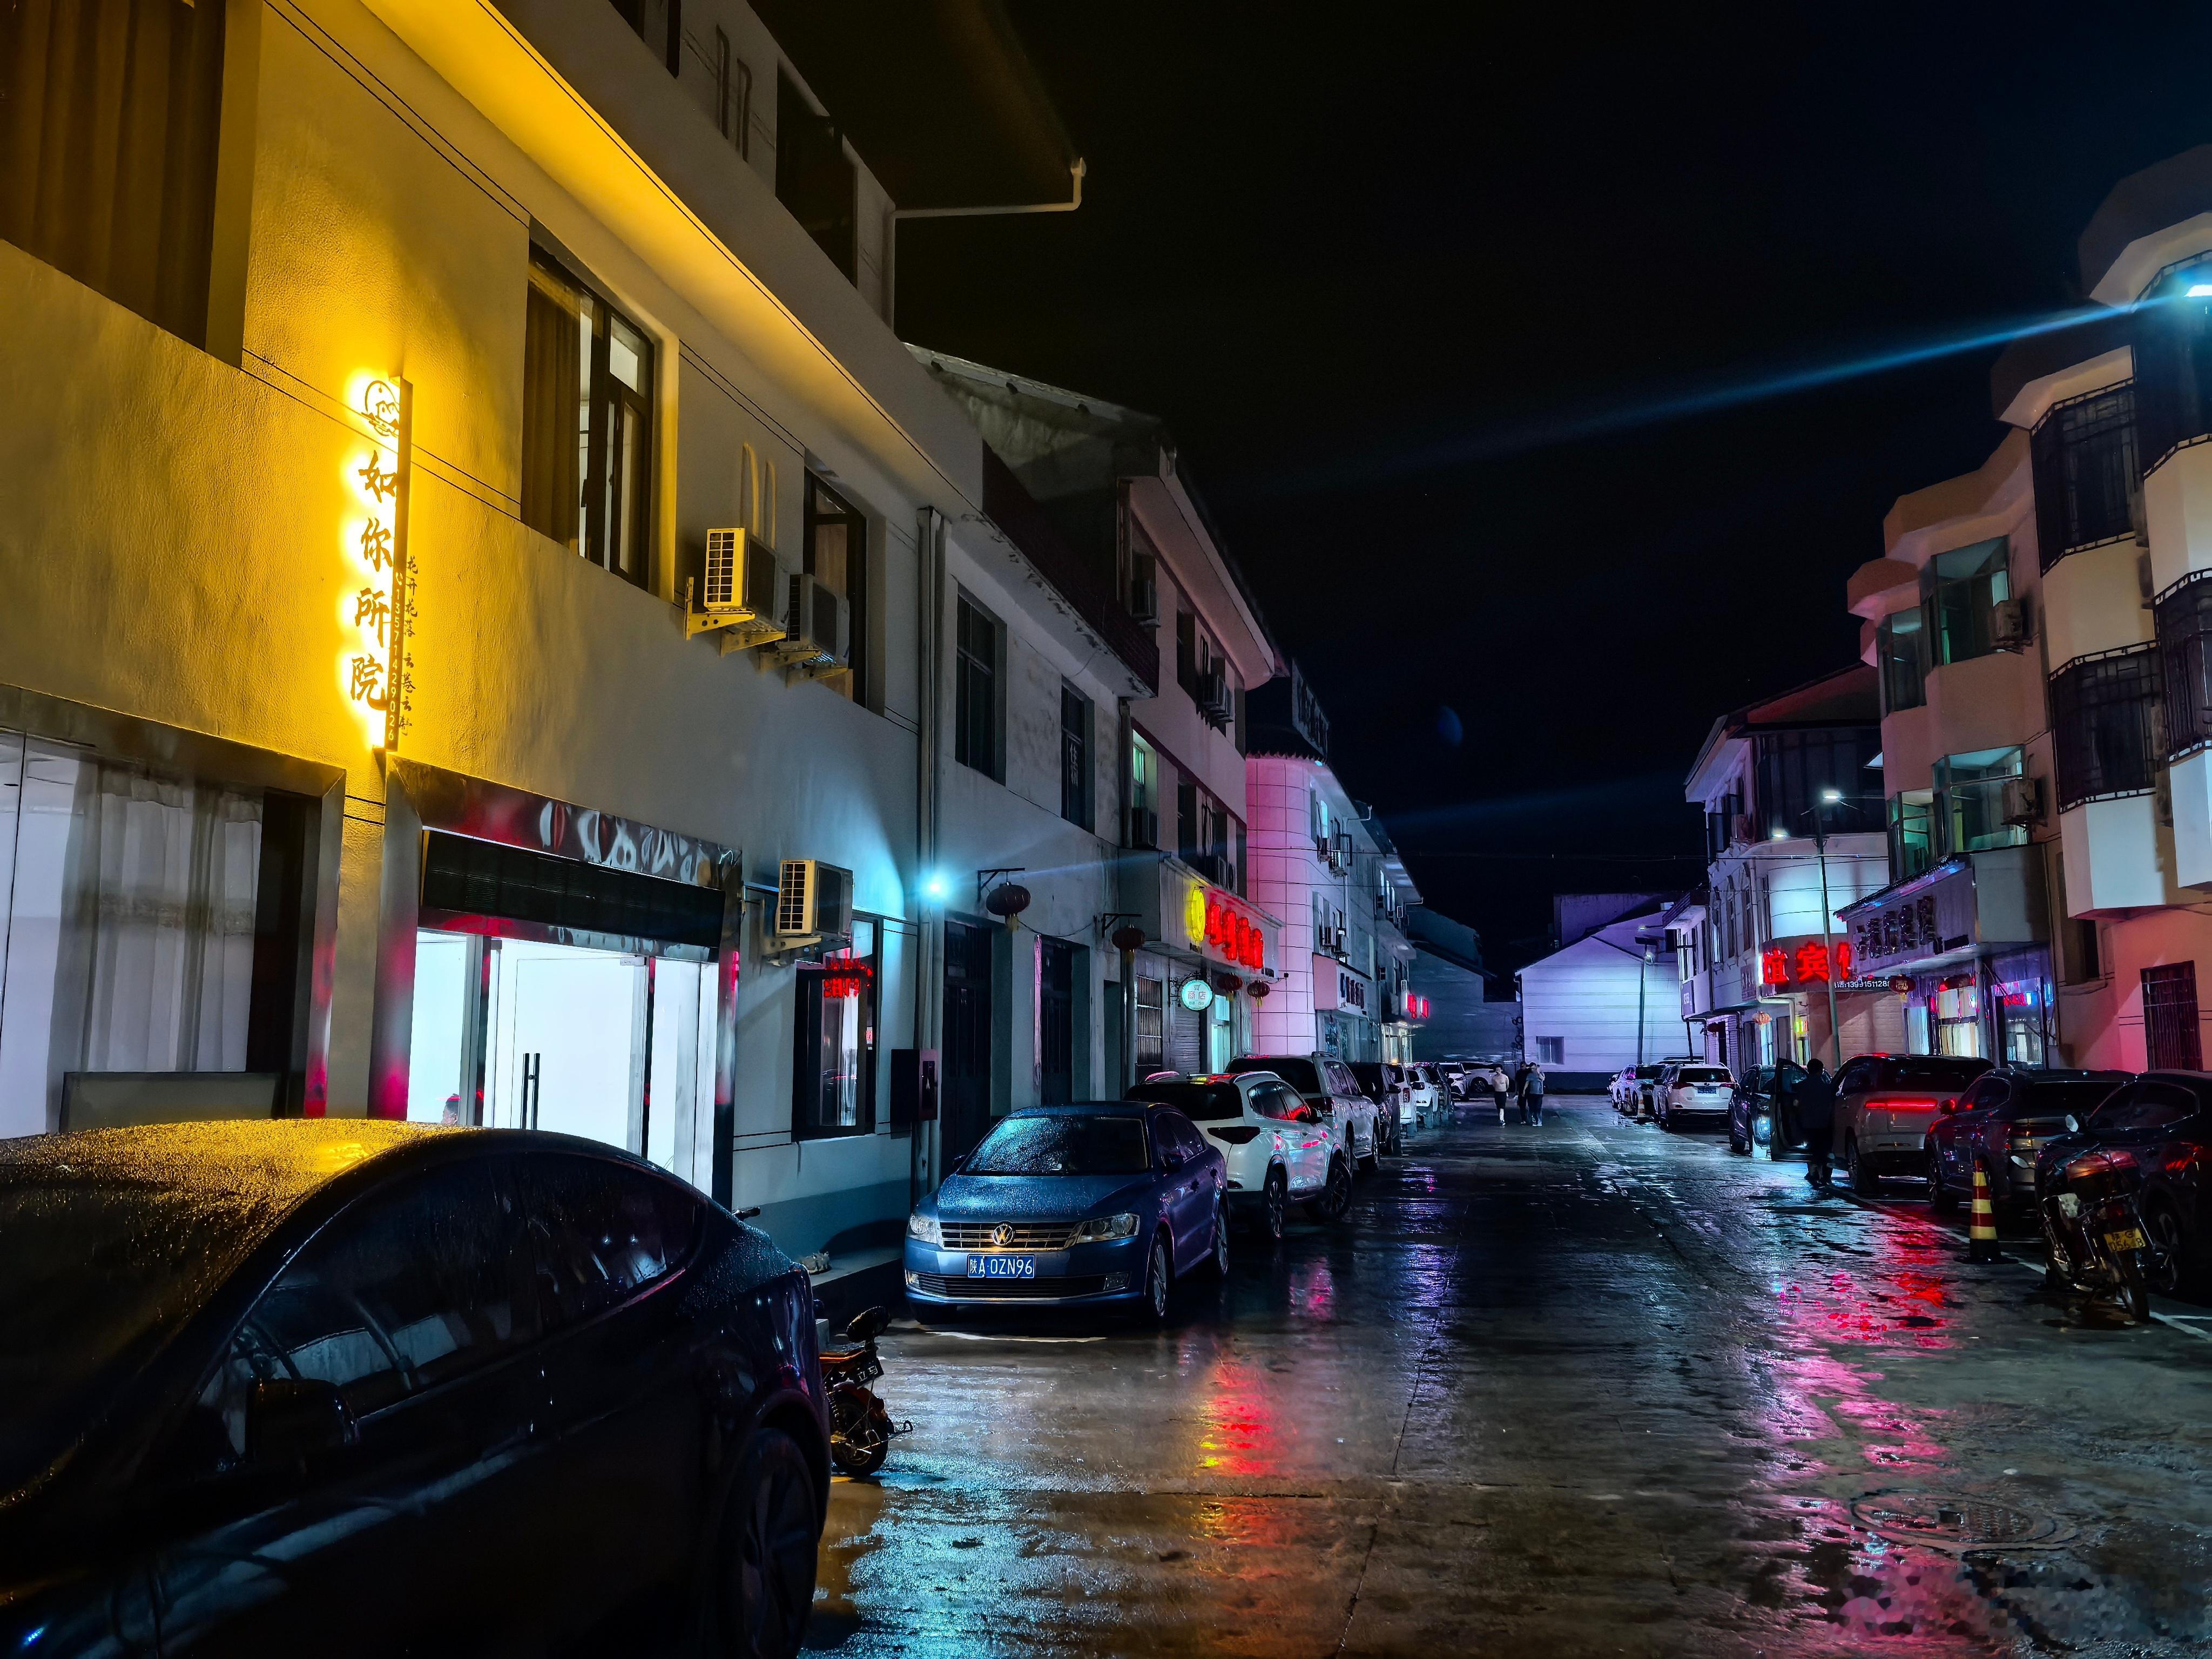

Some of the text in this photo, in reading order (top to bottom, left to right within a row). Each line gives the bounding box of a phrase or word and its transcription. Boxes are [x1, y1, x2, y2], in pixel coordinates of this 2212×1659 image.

[350, 449, 398, 711] 如你所院
[388, 589, 400, 741] 13571429026
[1188, 991, 1206, 1000] 商店
